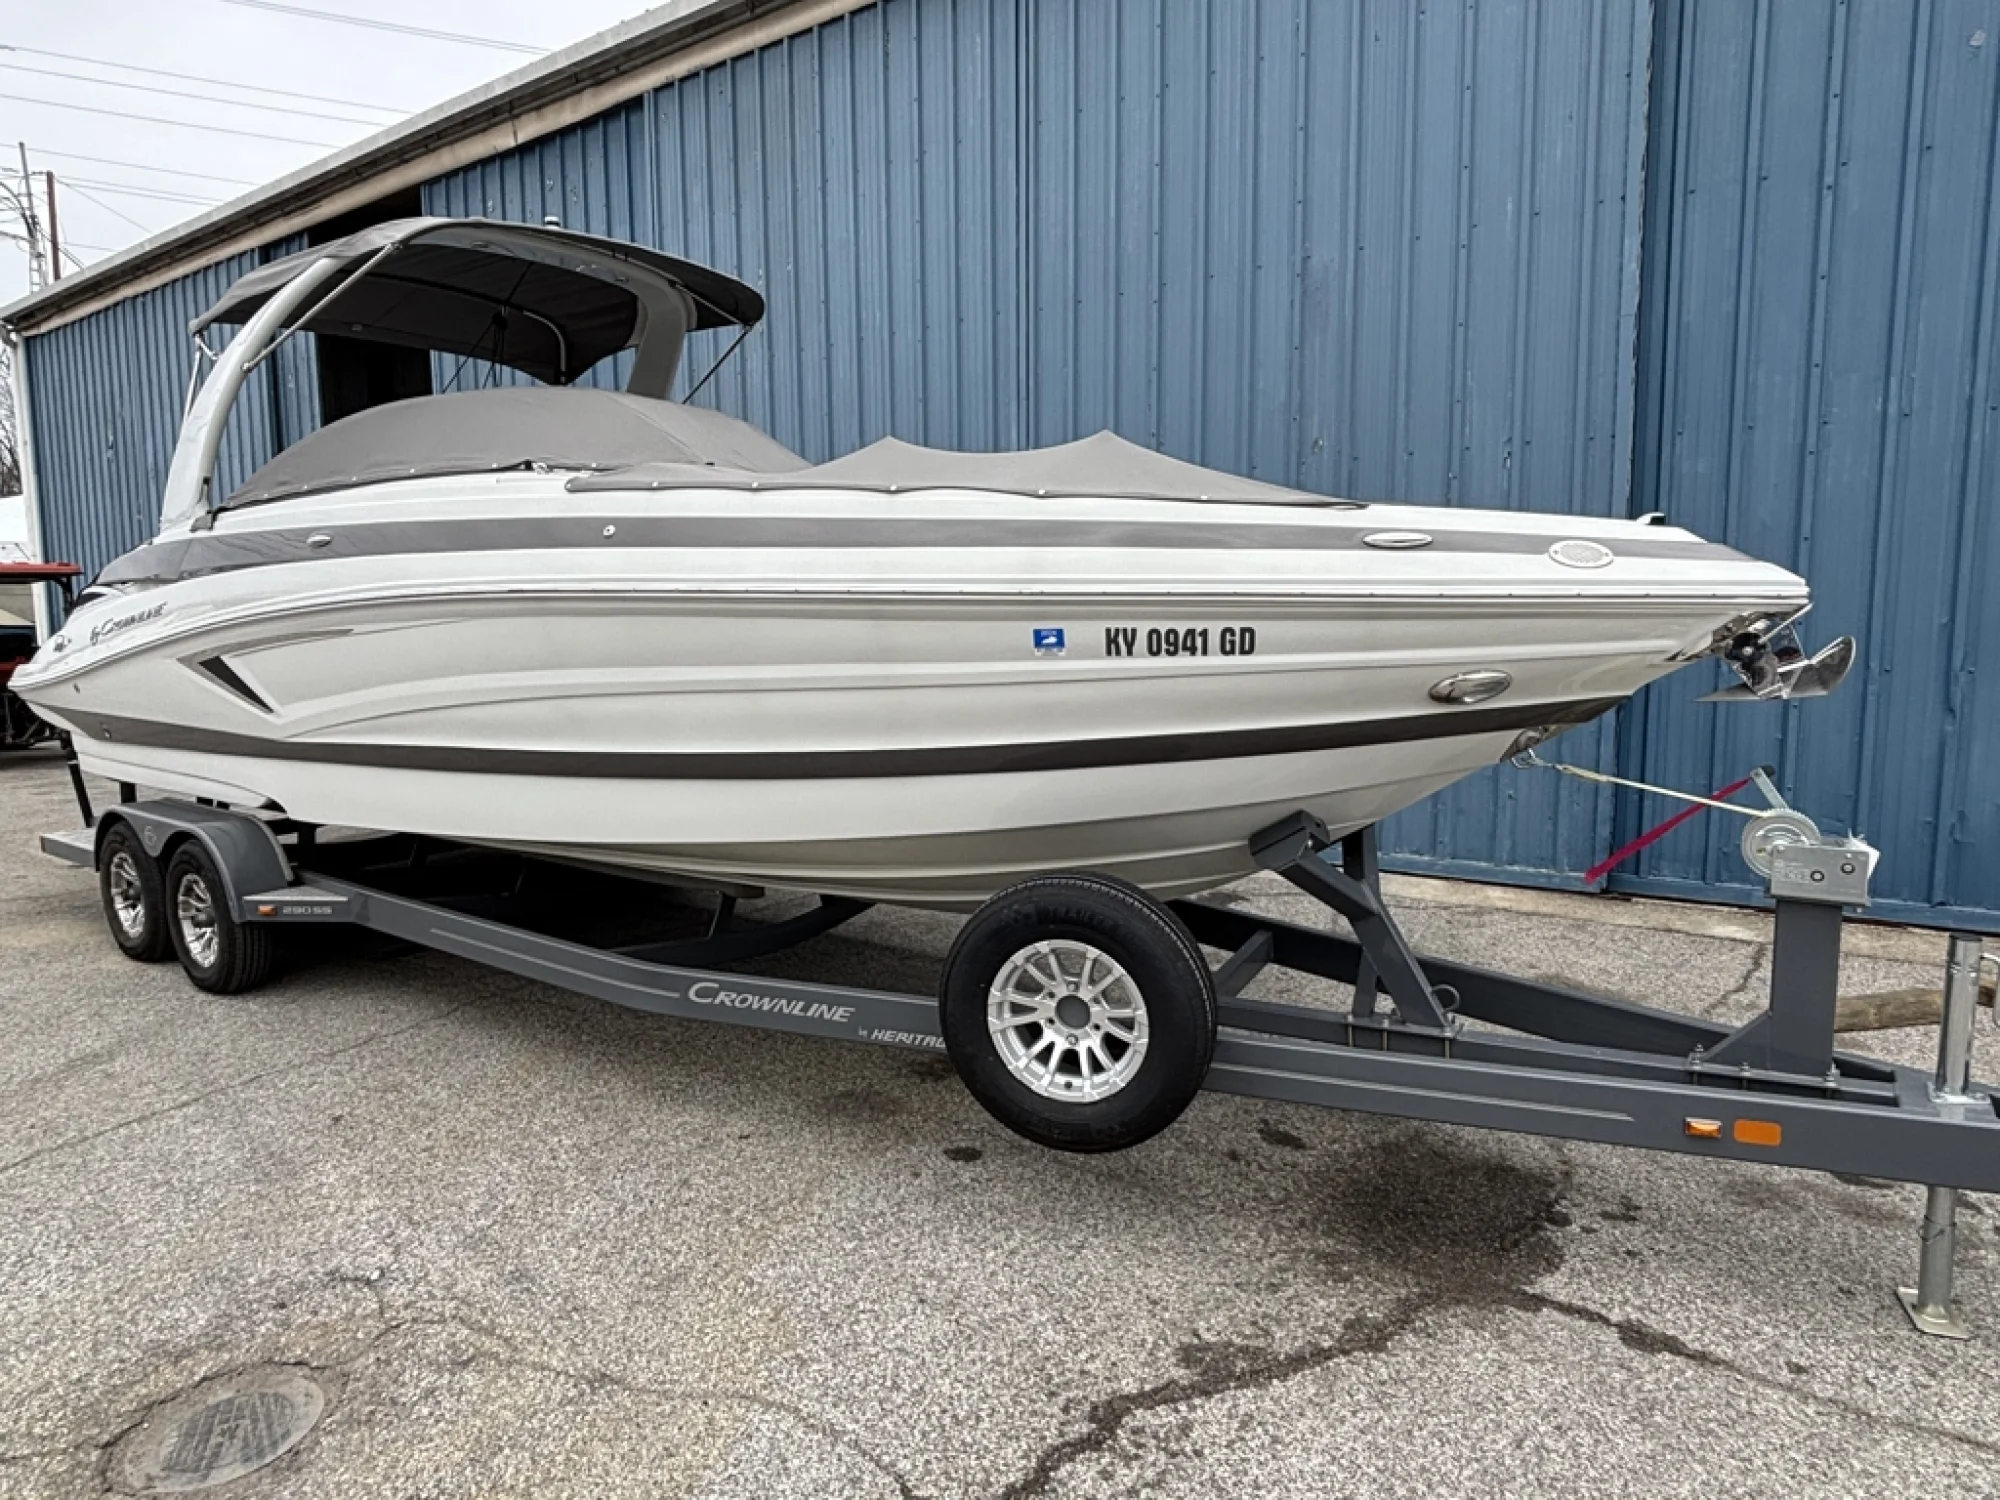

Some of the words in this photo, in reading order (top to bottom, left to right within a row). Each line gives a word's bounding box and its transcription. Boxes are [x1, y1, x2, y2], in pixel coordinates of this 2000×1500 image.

[1105, 627, 1137, 657] KY
[1147, 628, 1209, 657] 0941
[1219, 627, 1256, 656] GD
[688, 982, 856, 1022] CROWNLINE
[871, 1029, 946, 1048] HERITAG
